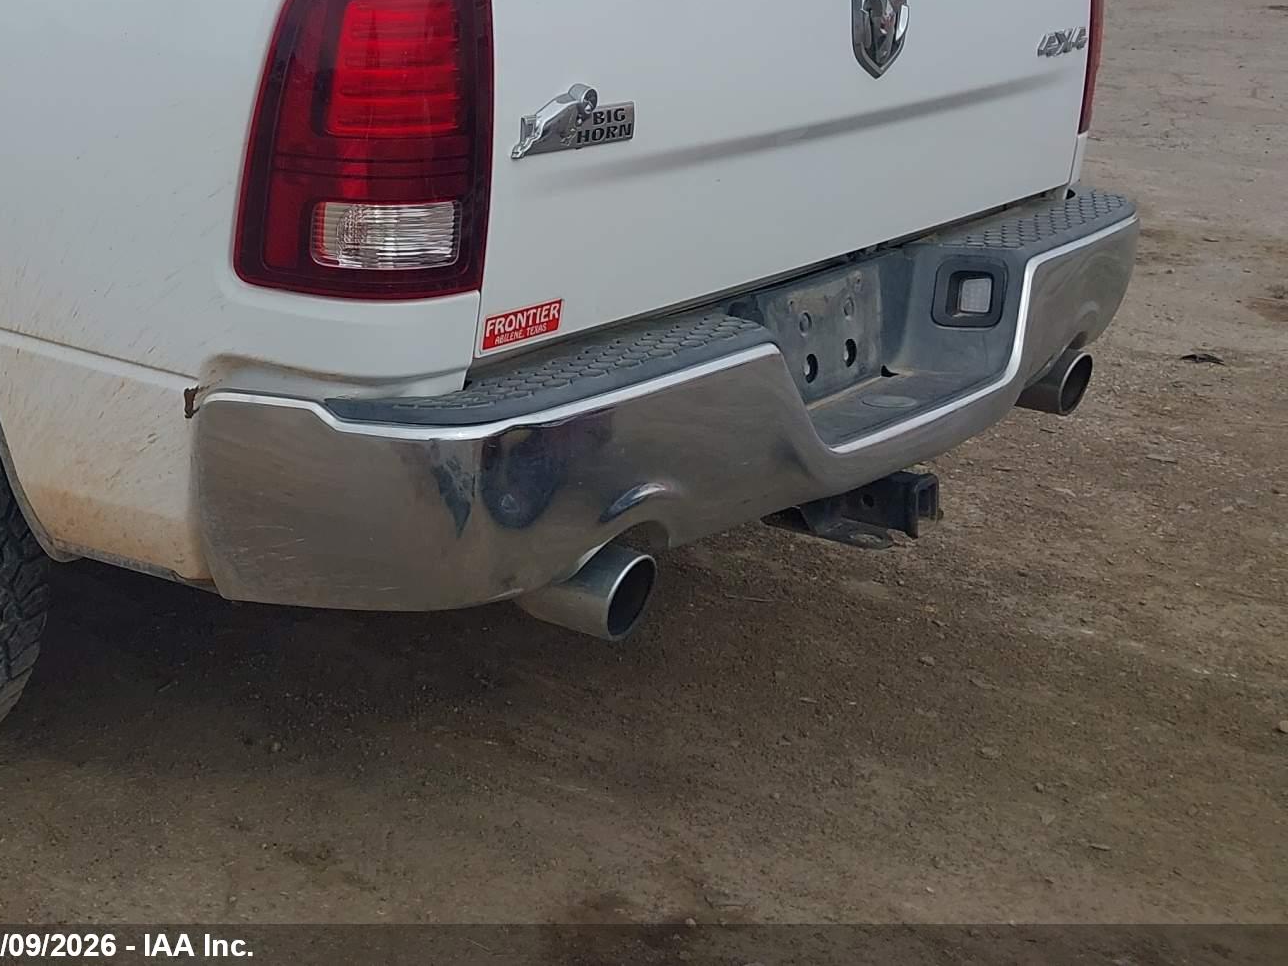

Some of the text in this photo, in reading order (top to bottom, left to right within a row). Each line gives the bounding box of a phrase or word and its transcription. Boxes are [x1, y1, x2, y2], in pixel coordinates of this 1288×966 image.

[592, 108, 627, 126] BIG
[576, 123, 632, 144] HORN
[485, 303, 561, 338] FRONTIER
[526, 323, 547, 337] TEXAS
